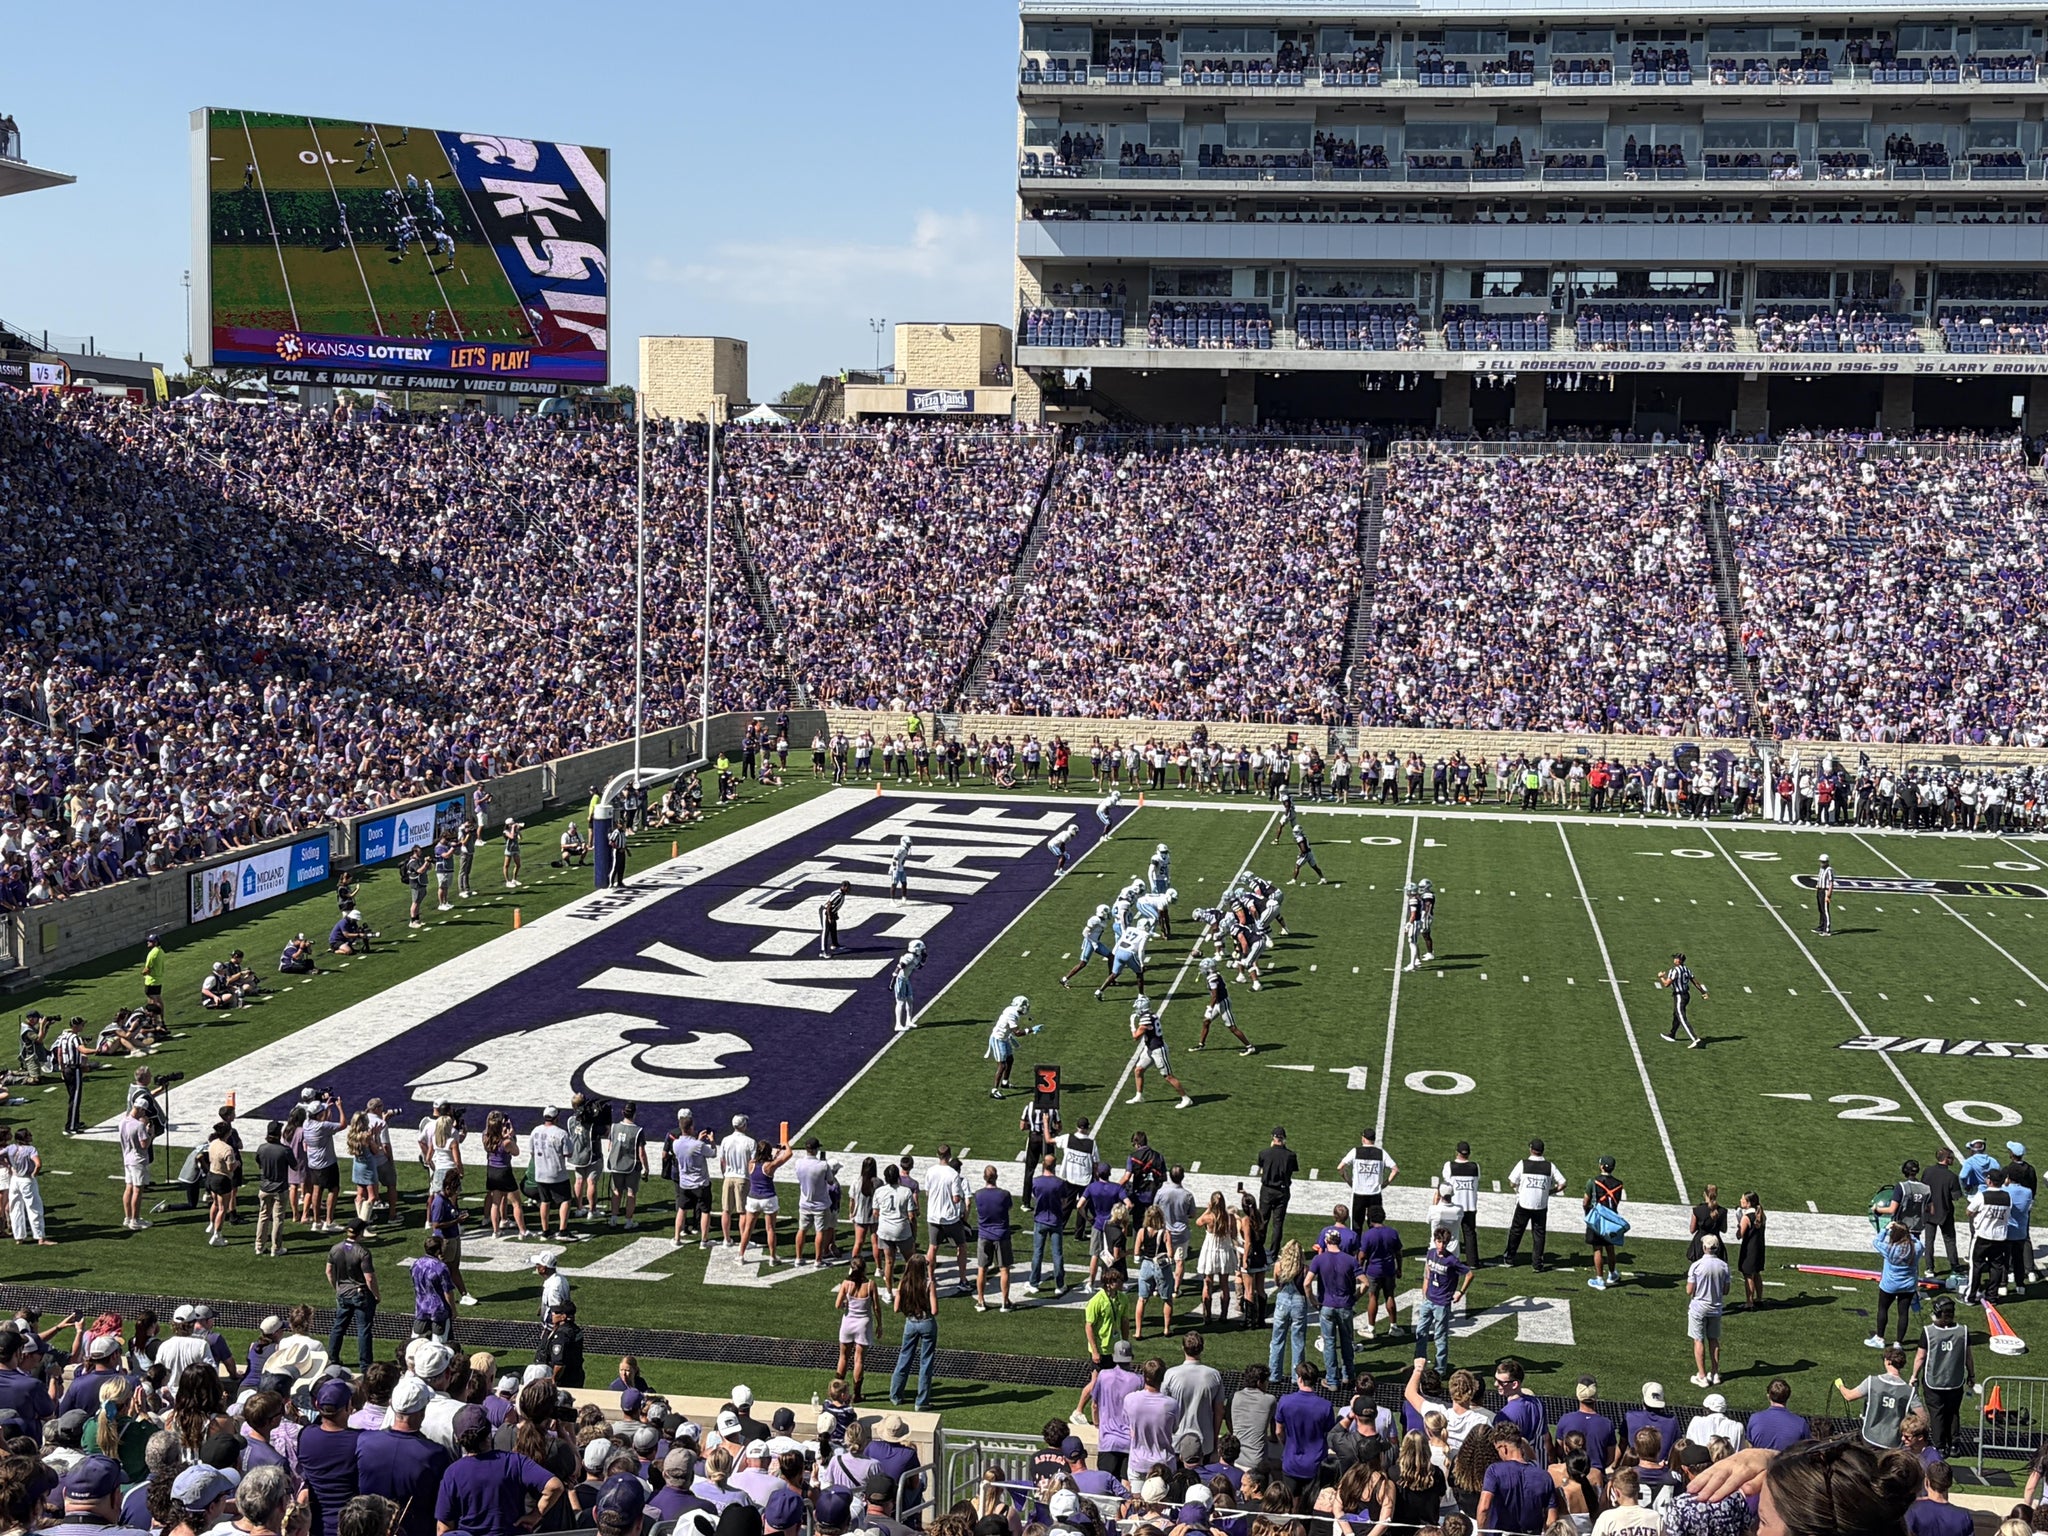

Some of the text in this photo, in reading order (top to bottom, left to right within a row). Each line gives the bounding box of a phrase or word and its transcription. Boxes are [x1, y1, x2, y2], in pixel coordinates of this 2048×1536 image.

[307, 341, 364, 358] KANSAS
[368, 345, 433, 361] LOTTERY
[451, 347, 530, 371] LET'S PLAY!
[1491, 361, 1515, 370] ELL
[1520, 361, 1597, 370] ROBERSON
[1600, 361, 1666, 370] 2000-03
[1681, 361, 1899, 372] 49 DARREN HOWARD 1996-99
[1914, 363, 2048, 373] 36 LARRY BROWN
[273, 369, 557, 394] CARL & MARY ICE FAMILY VIDEO BOARD
[914, 392, 968, 409] Pizza Ranch
[257, 867, 284, 883] MIDLAND
[578, 803, 1077, 1014] K-STATE
[1037, 1070, 1058, 1093] 3
[1329, 1065, 1476, 1095] 10
[1828, 1094, 2023, 1127] 20
[888, 1194, 897, 1212] 1
[1882, 1397, 1896, 1409] 58
